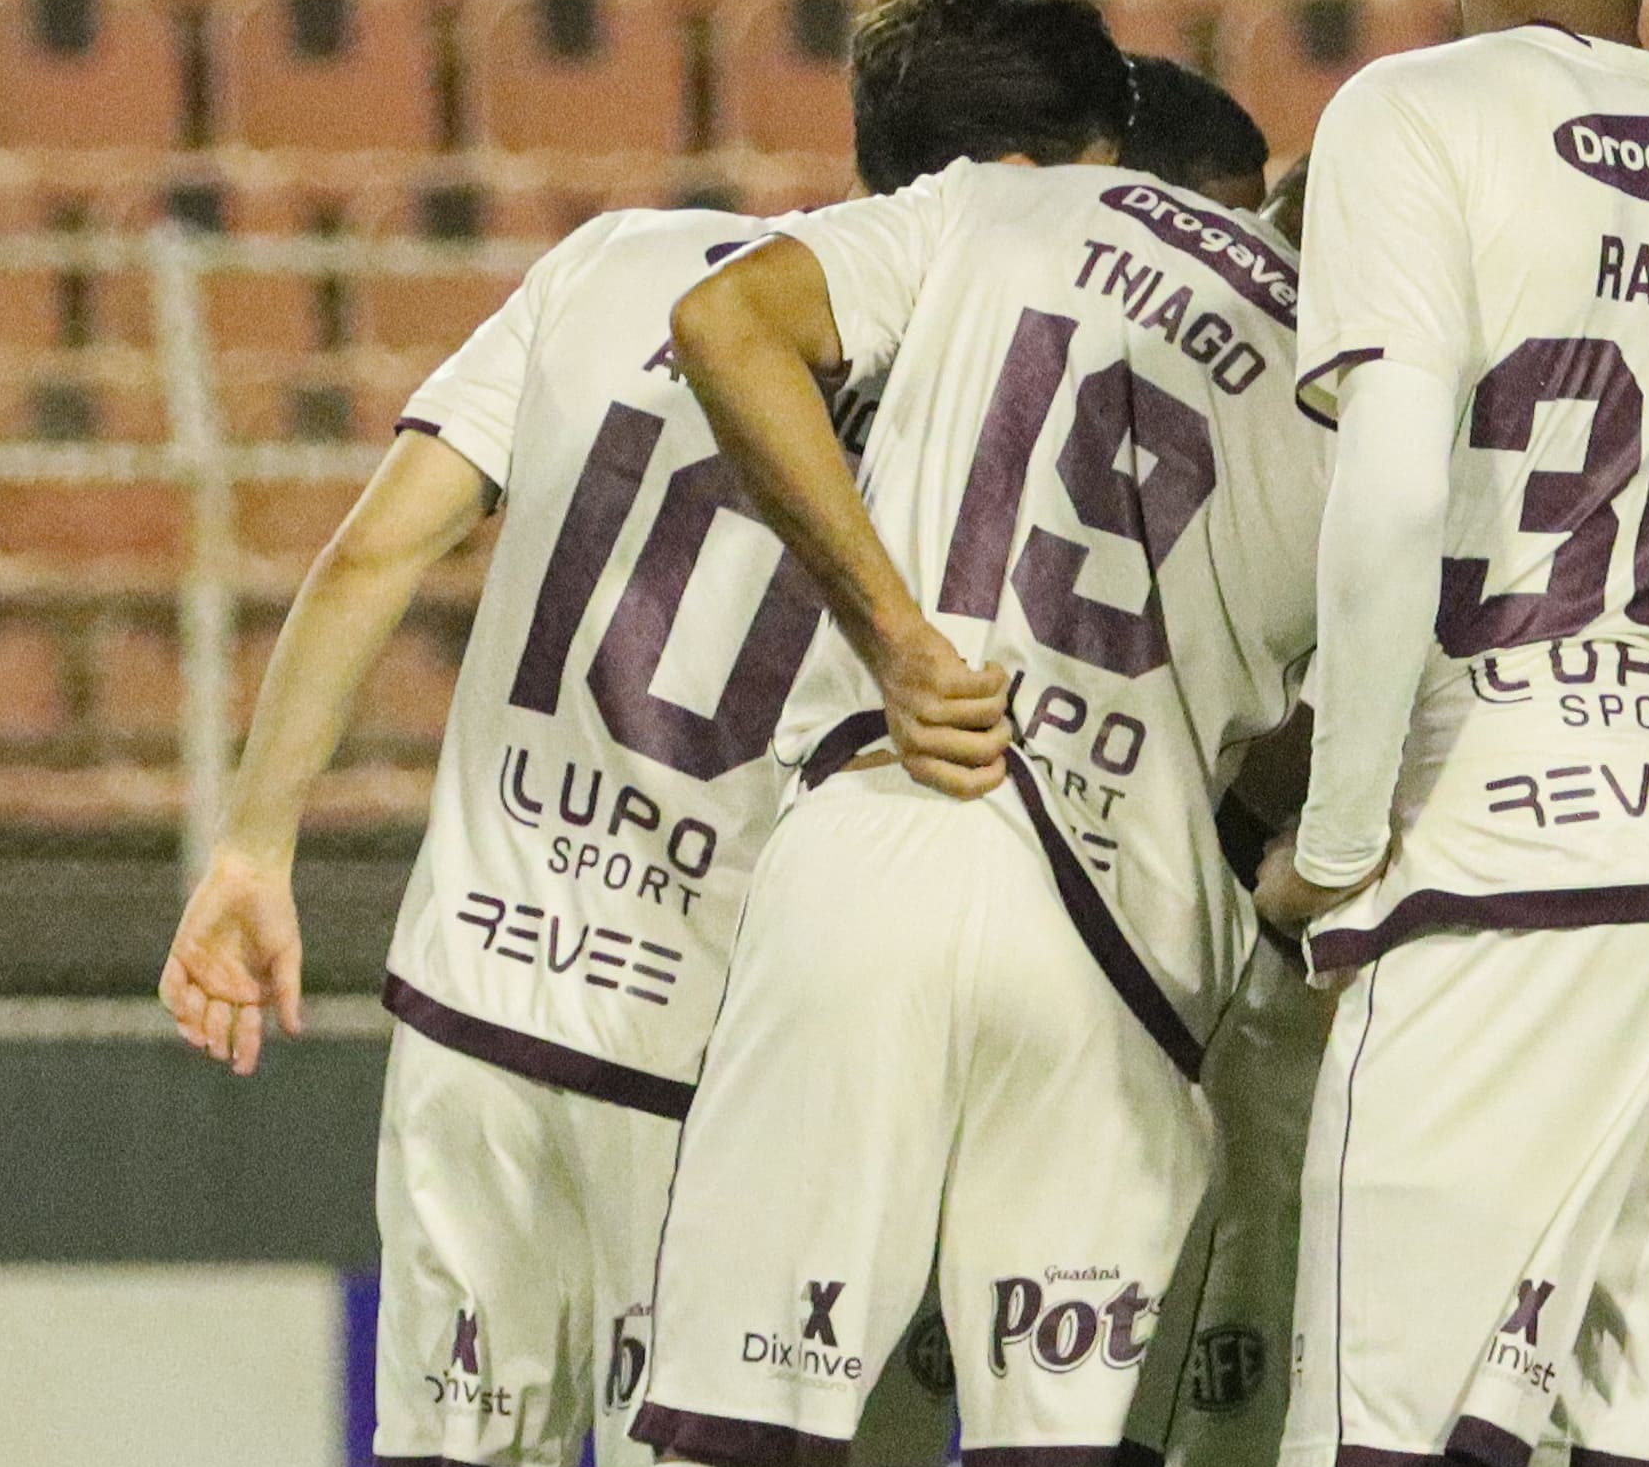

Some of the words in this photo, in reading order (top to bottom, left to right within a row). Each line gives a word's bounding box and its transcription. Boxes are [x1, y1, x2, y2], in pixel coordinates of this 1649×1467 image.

[1074, 238, 1267, 395] THIAGO
[937, 306, 1217, 679] 19
[509, 400, 826, 781] 10
[1006, 670, 1147, 776] PO
[500, 745, 717, 879] LUPO
[548, 836, 701, 916] SPORT
[742, 1332, 793, 1368] Dix
[799, 1343, 863, 1380] Inve
[989, 1278, 1158, 1379] Pot
